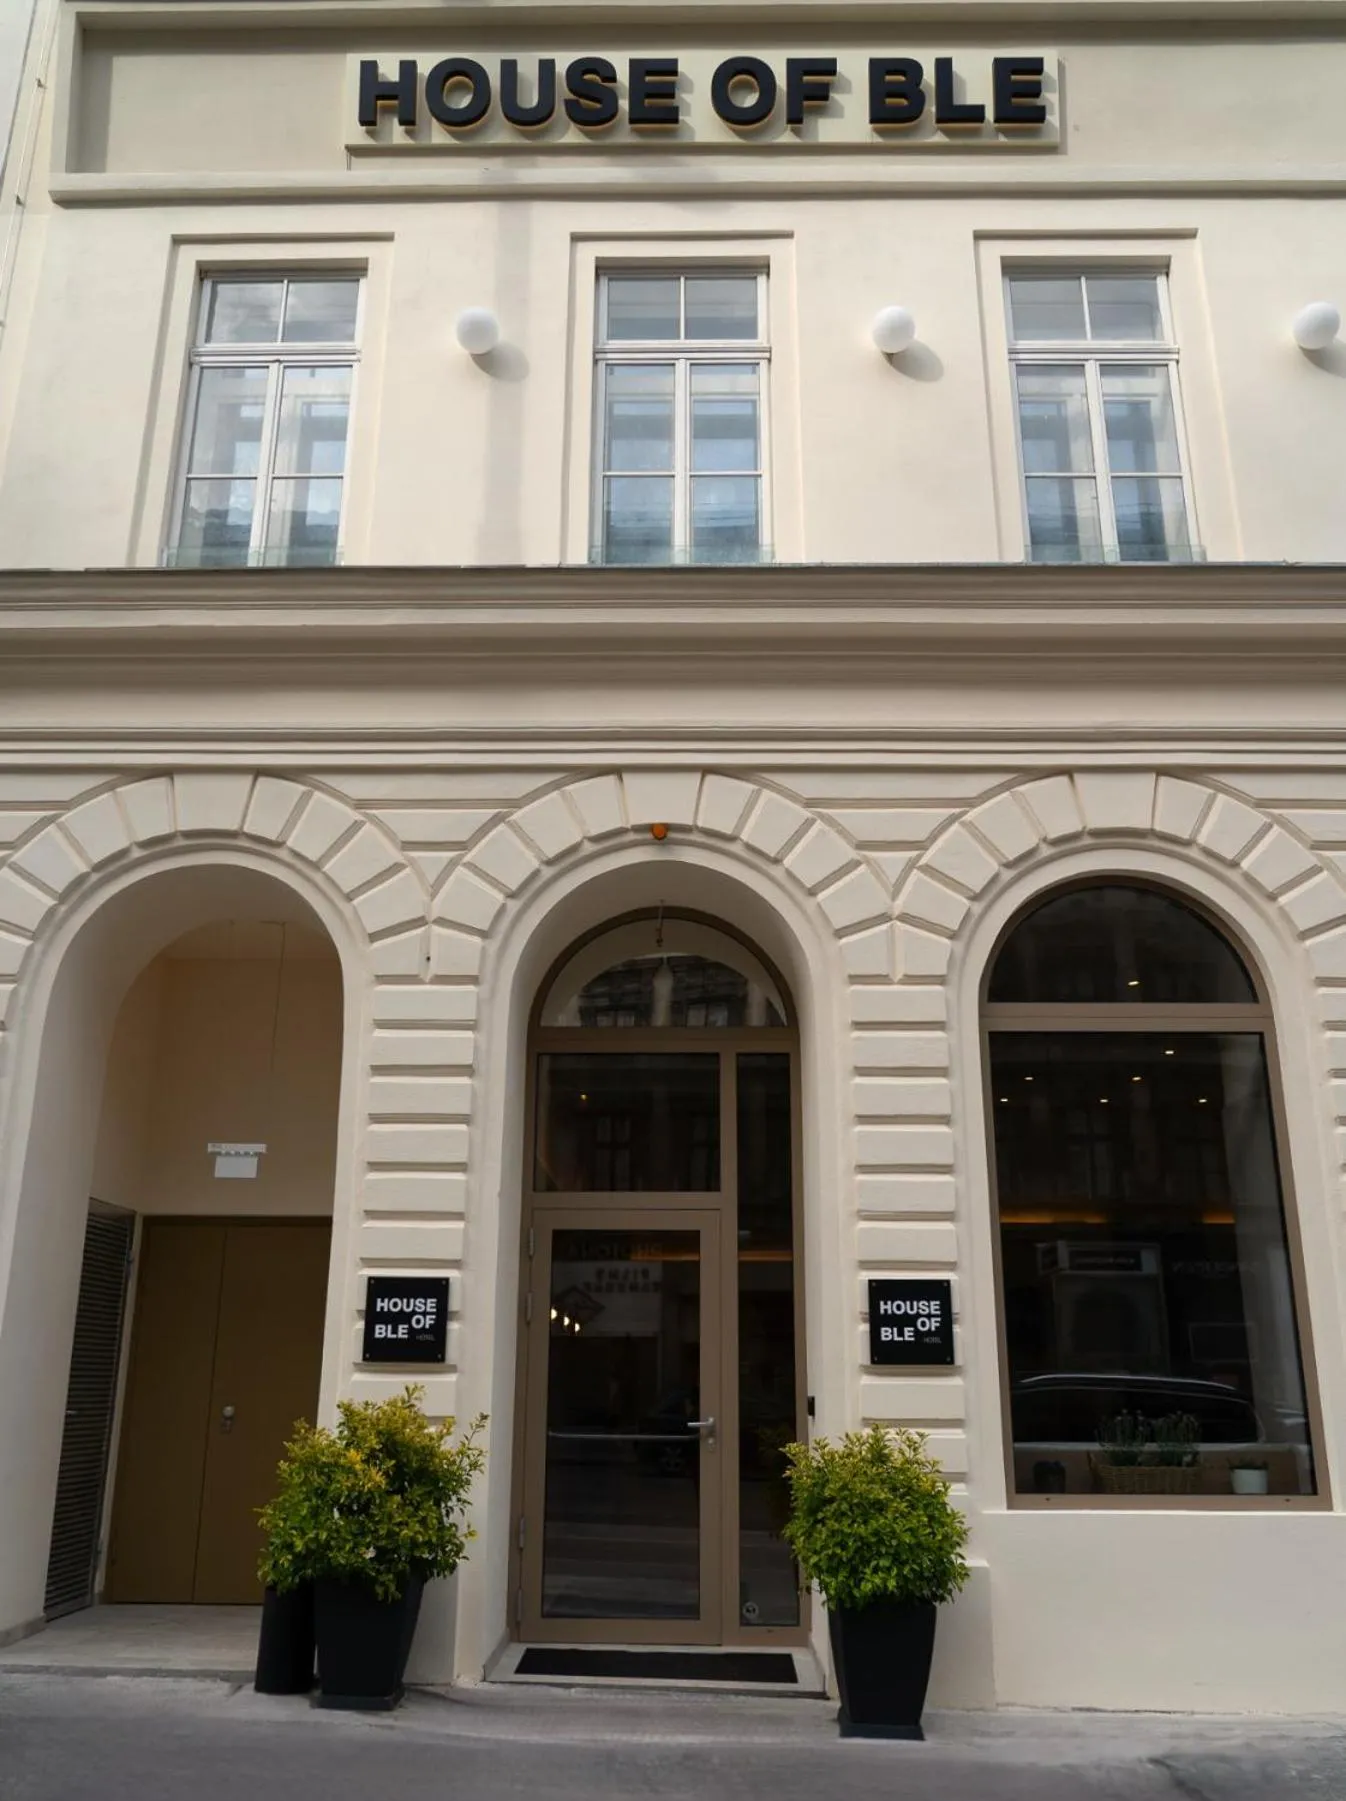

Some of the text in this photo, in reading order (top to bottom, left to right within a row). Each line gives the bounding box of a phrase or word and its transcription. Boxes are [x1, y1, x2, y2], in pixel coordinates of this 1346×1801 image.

[358, 56, 1047, 128] HOUSE OF BLE
[376, 1298, 437, 1312] HOUSE
[880, 1300, 941, 1315] HOUSE
[411, 1314, 436, 1329] OF
[916, 1317, 941, 1331] OF
[374, 1324, 409, 1338] BLE
[880, 1327, 915, 1341] BLE
